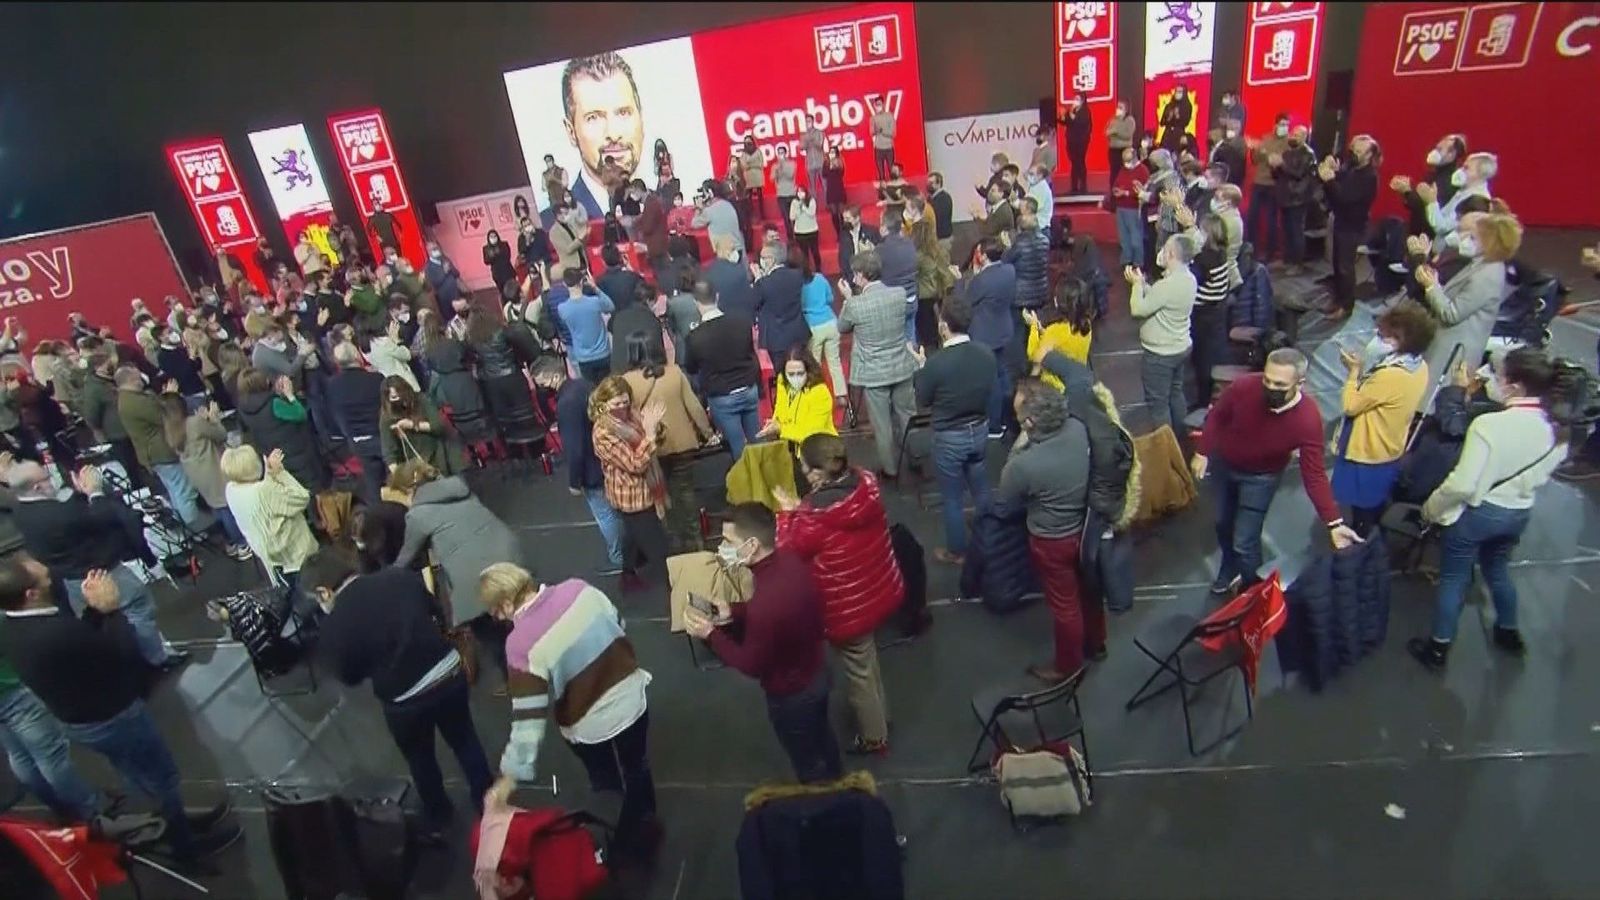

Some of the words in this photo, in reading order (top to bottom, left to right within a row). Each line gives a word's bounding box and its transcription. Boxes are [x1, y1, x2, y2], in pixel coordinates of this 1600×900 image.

[1065, 2, 1107, 20] PSOE
[1407, 20, 1458, 43] PSOE
[820, 34, 853, 51] PSOE
[726, 94, 864, 143] Cambio
[342, 126, 382, 148] PSOE
[184, 158, 226, 178] PSOE
[459, 207, 485, 221] PSOE
[26, 246, 73, 298] y
